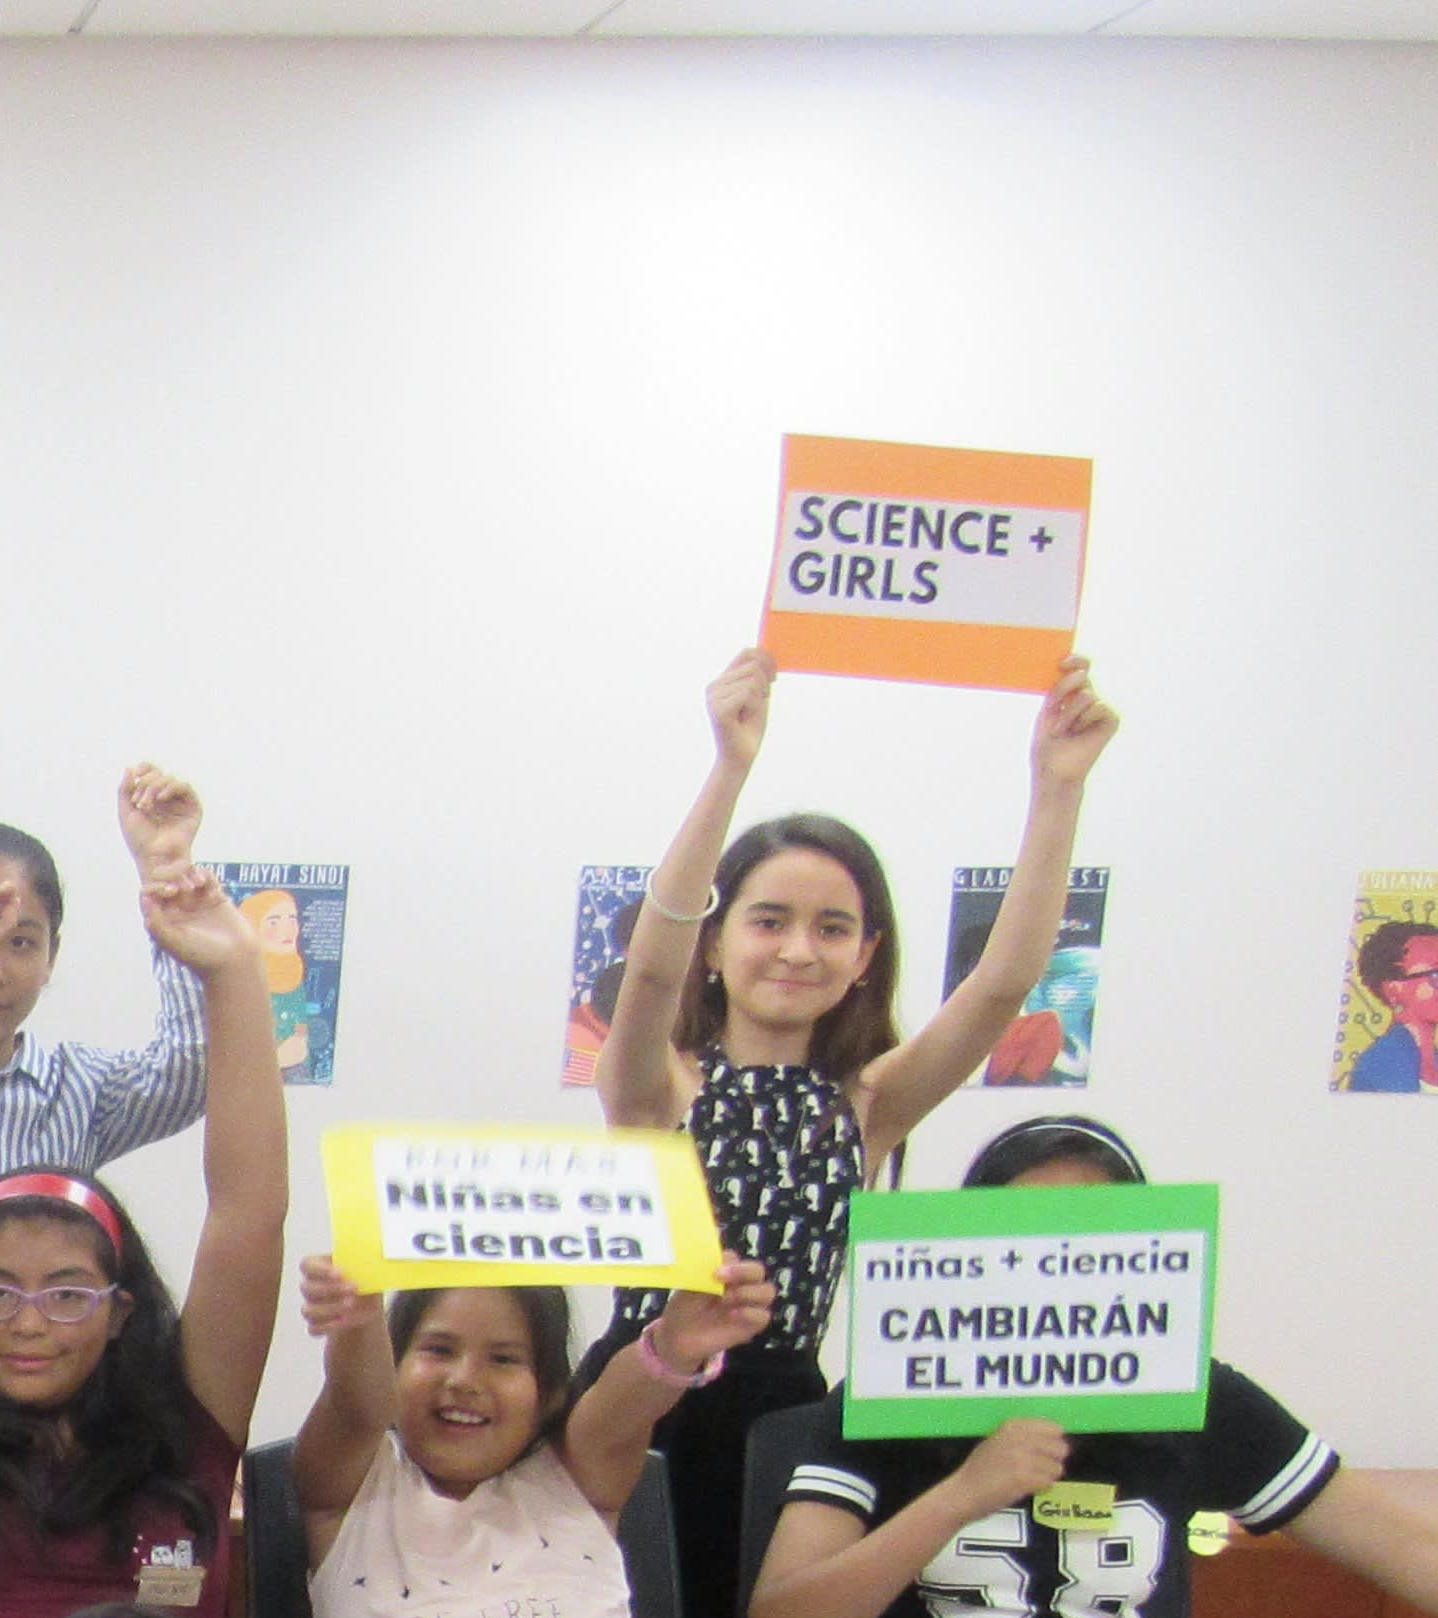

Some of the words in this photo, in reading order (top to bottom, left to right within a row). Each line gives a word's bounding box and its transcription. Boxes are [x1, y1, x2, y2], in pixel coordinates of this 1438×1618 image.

[794, 495, 1013, 557] SCIENCE
[1028, 526, 1053, 553] +
[788, 550, 940, 605] GIRLS
[239, 863, 291, 883] HAYAT
[299, 864, 345, 885] SINDI
[385, 1178, 563, 1213] Niñas
[578, 1190, 654, 1215] en
[412, 1222, 645, 1261] ciencia
[865, 1246, 985, 1280] niñas
[1000, 1249, 1023, 1271] +
[1037, 1239, 1190, 1277] ciencia
[879, 1292, 1169, 1342] CAMBIARÁN
[905, 1355, 962, 1390] EL
[975, 1351, 1141, 1388] MUNDO
